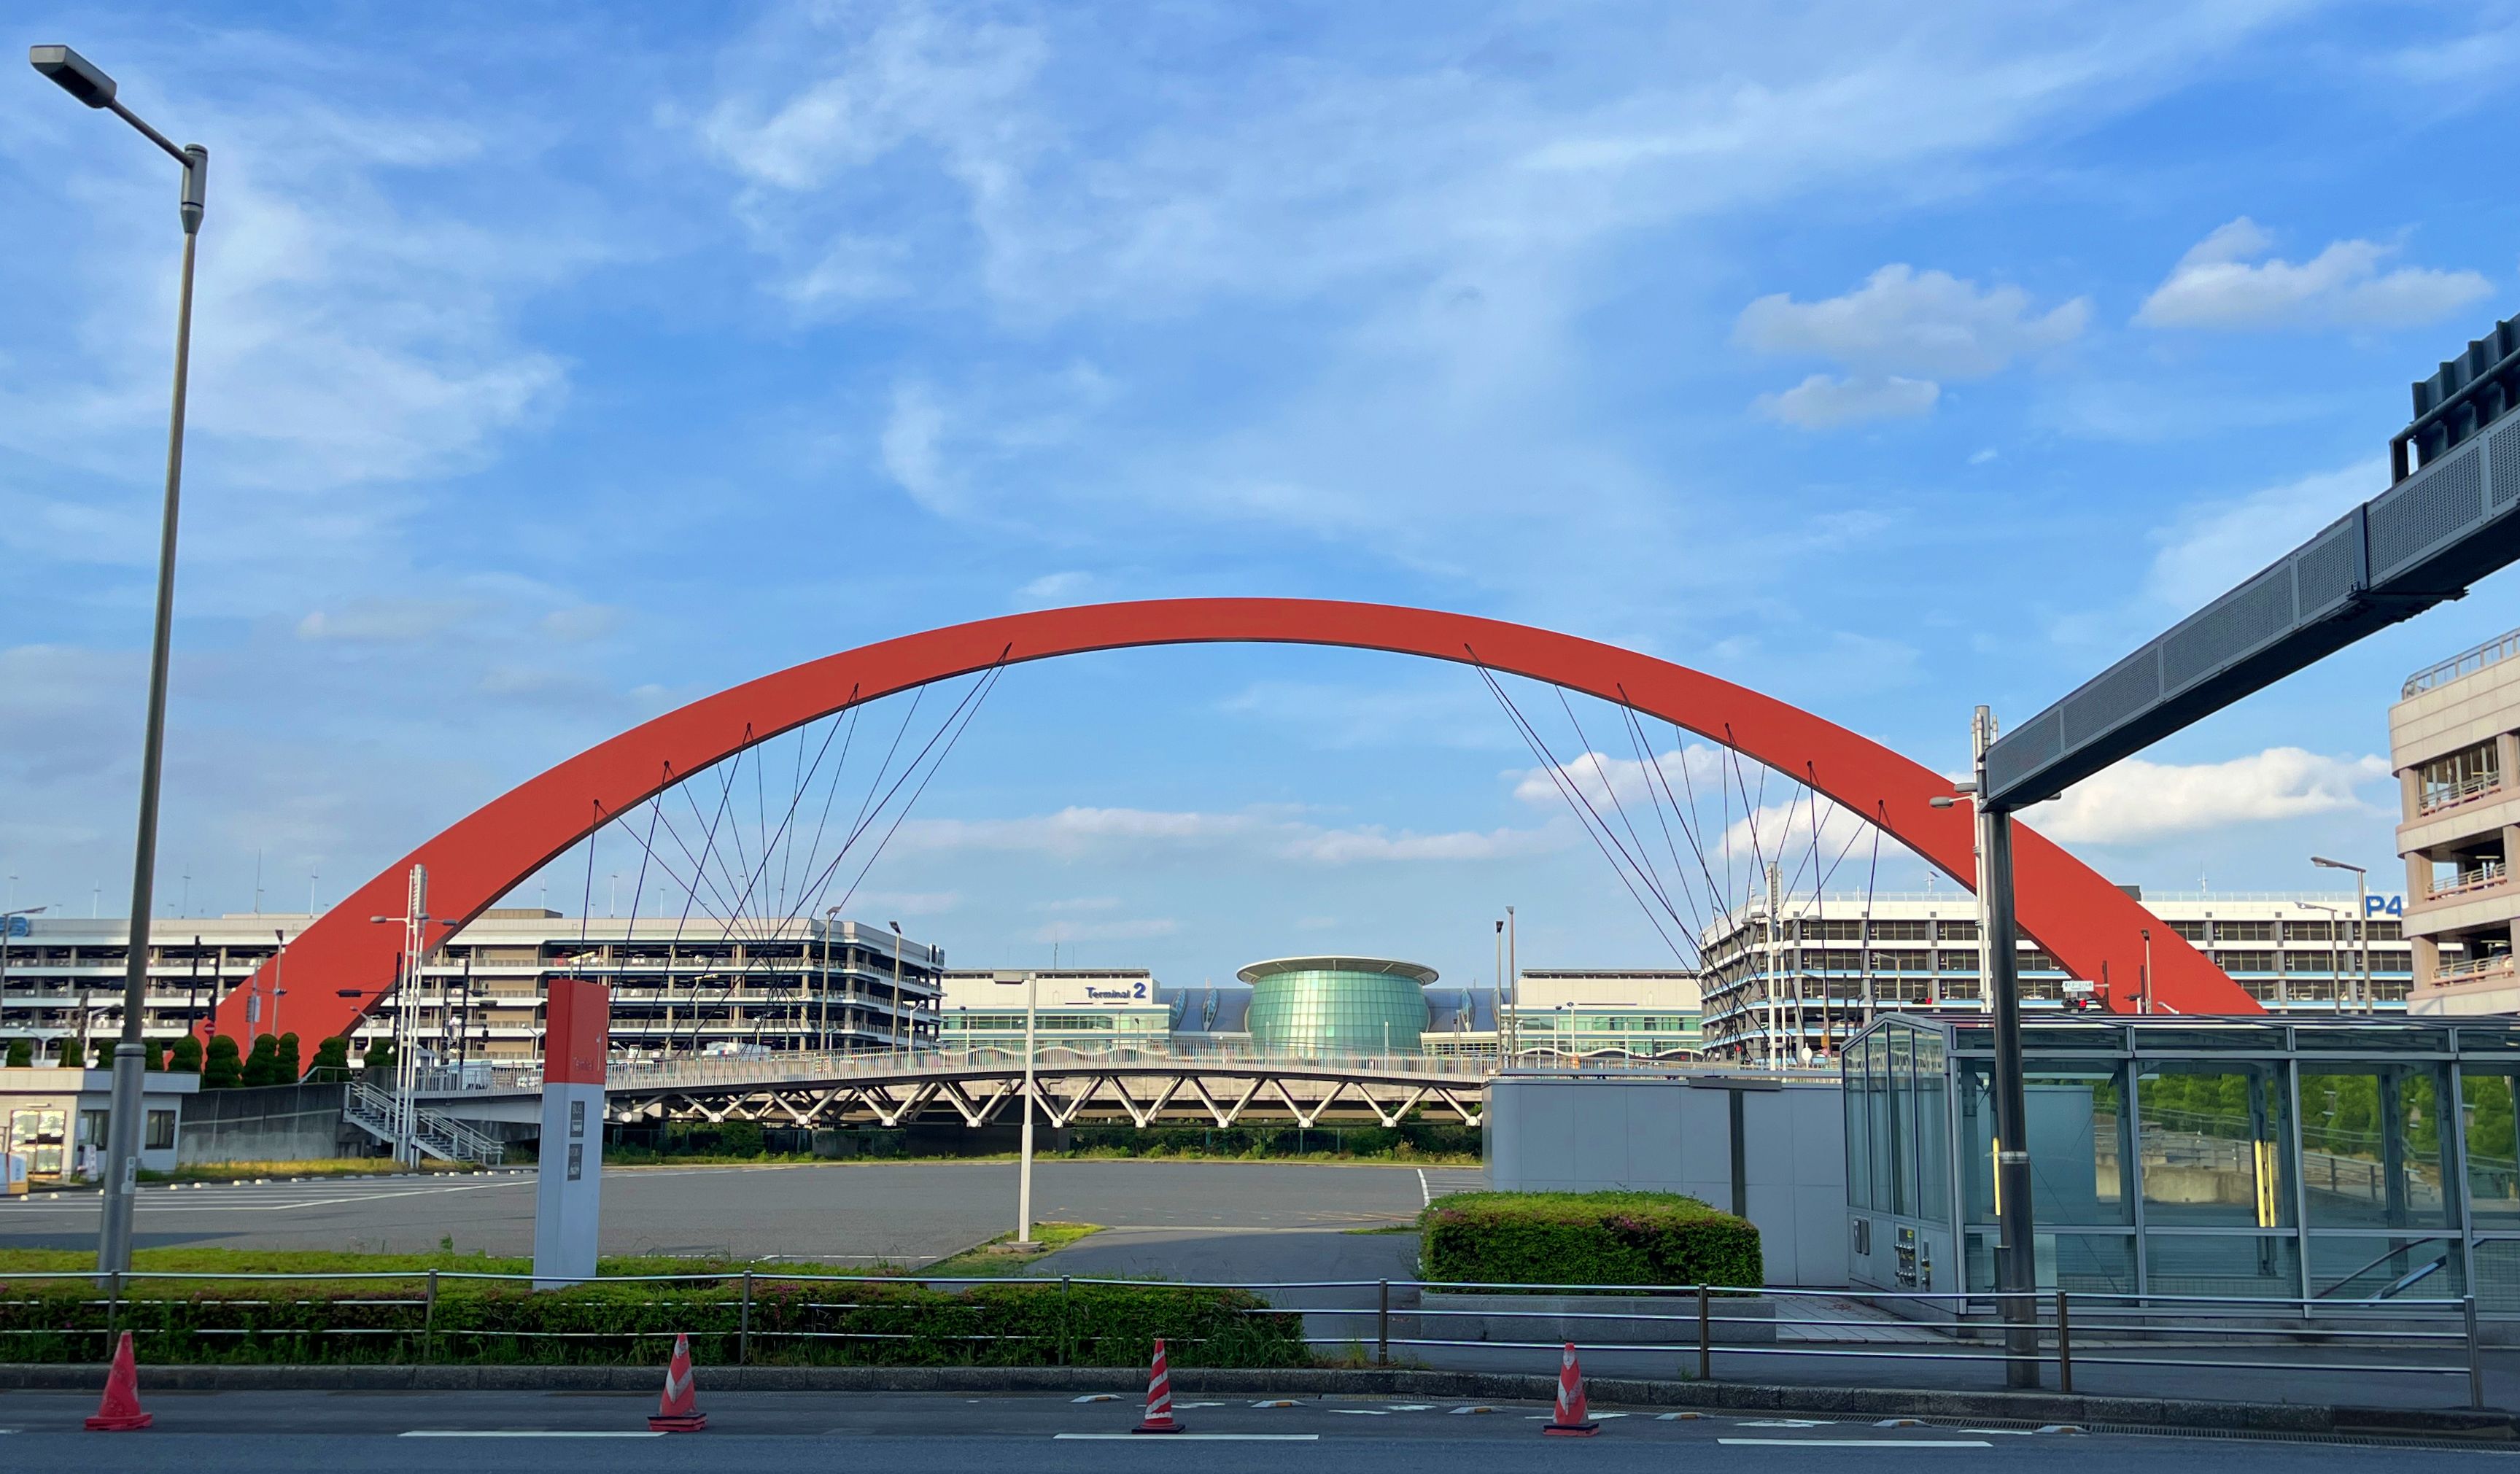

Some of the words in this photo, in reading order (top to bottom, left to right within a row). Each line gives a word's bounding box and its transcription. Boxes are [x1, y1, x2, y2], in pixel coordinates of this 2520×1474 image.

[2365, 896, 2403, 918] P4
[1085, 987, 1131, 998] Terminal
[1133, 982, 1146, 998] 2
[572, 1102, 583, 1114] BUS
